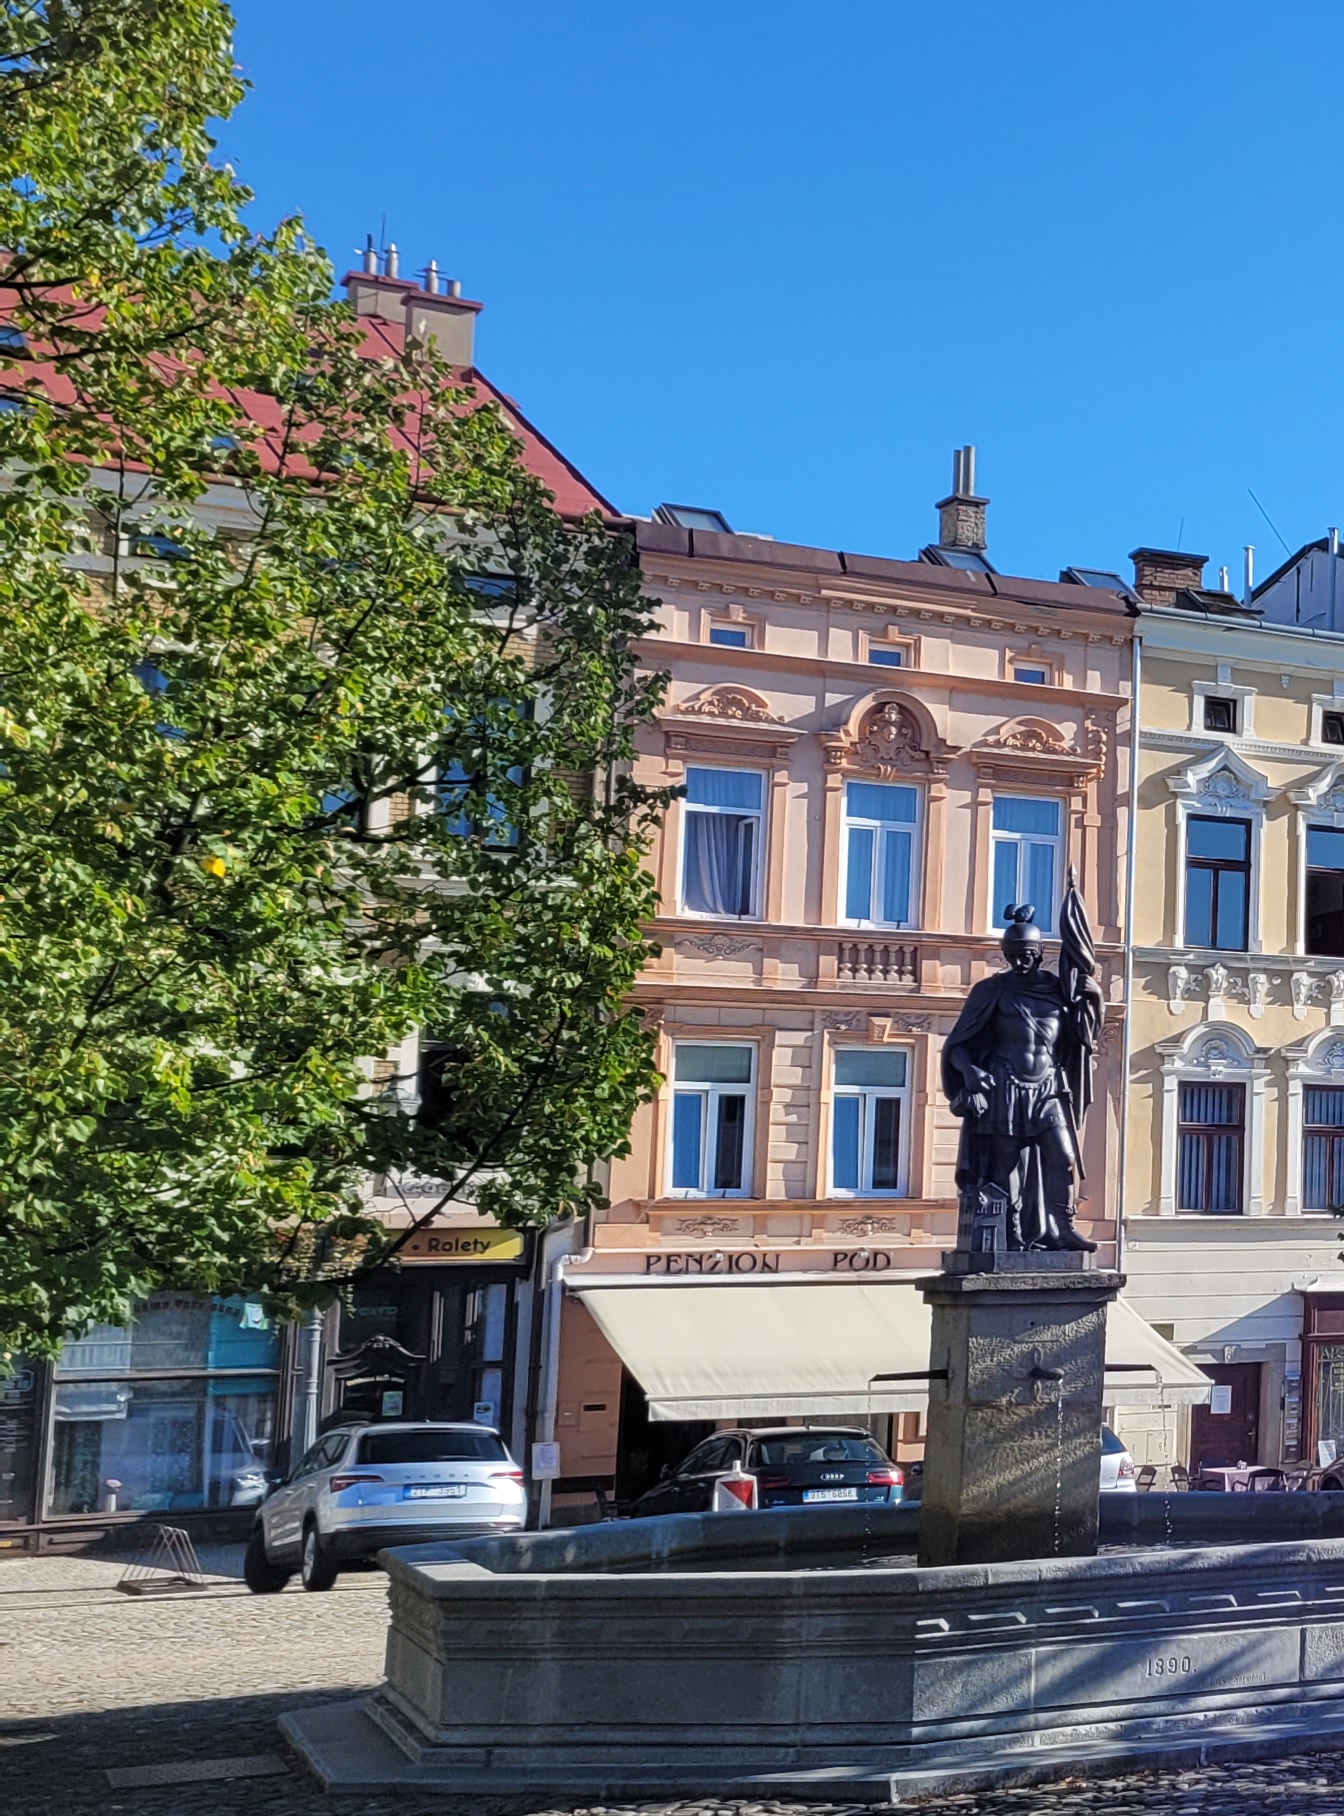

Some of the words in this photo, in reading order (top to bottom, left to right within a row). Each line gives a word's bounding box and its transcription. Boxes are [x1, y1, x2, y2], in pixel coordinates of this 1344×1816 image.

[428, 1237, 492, 1254] Rolety
[645, 1252, 781, 1274] PENZION
[832, 1252, 892, 1272] POD
